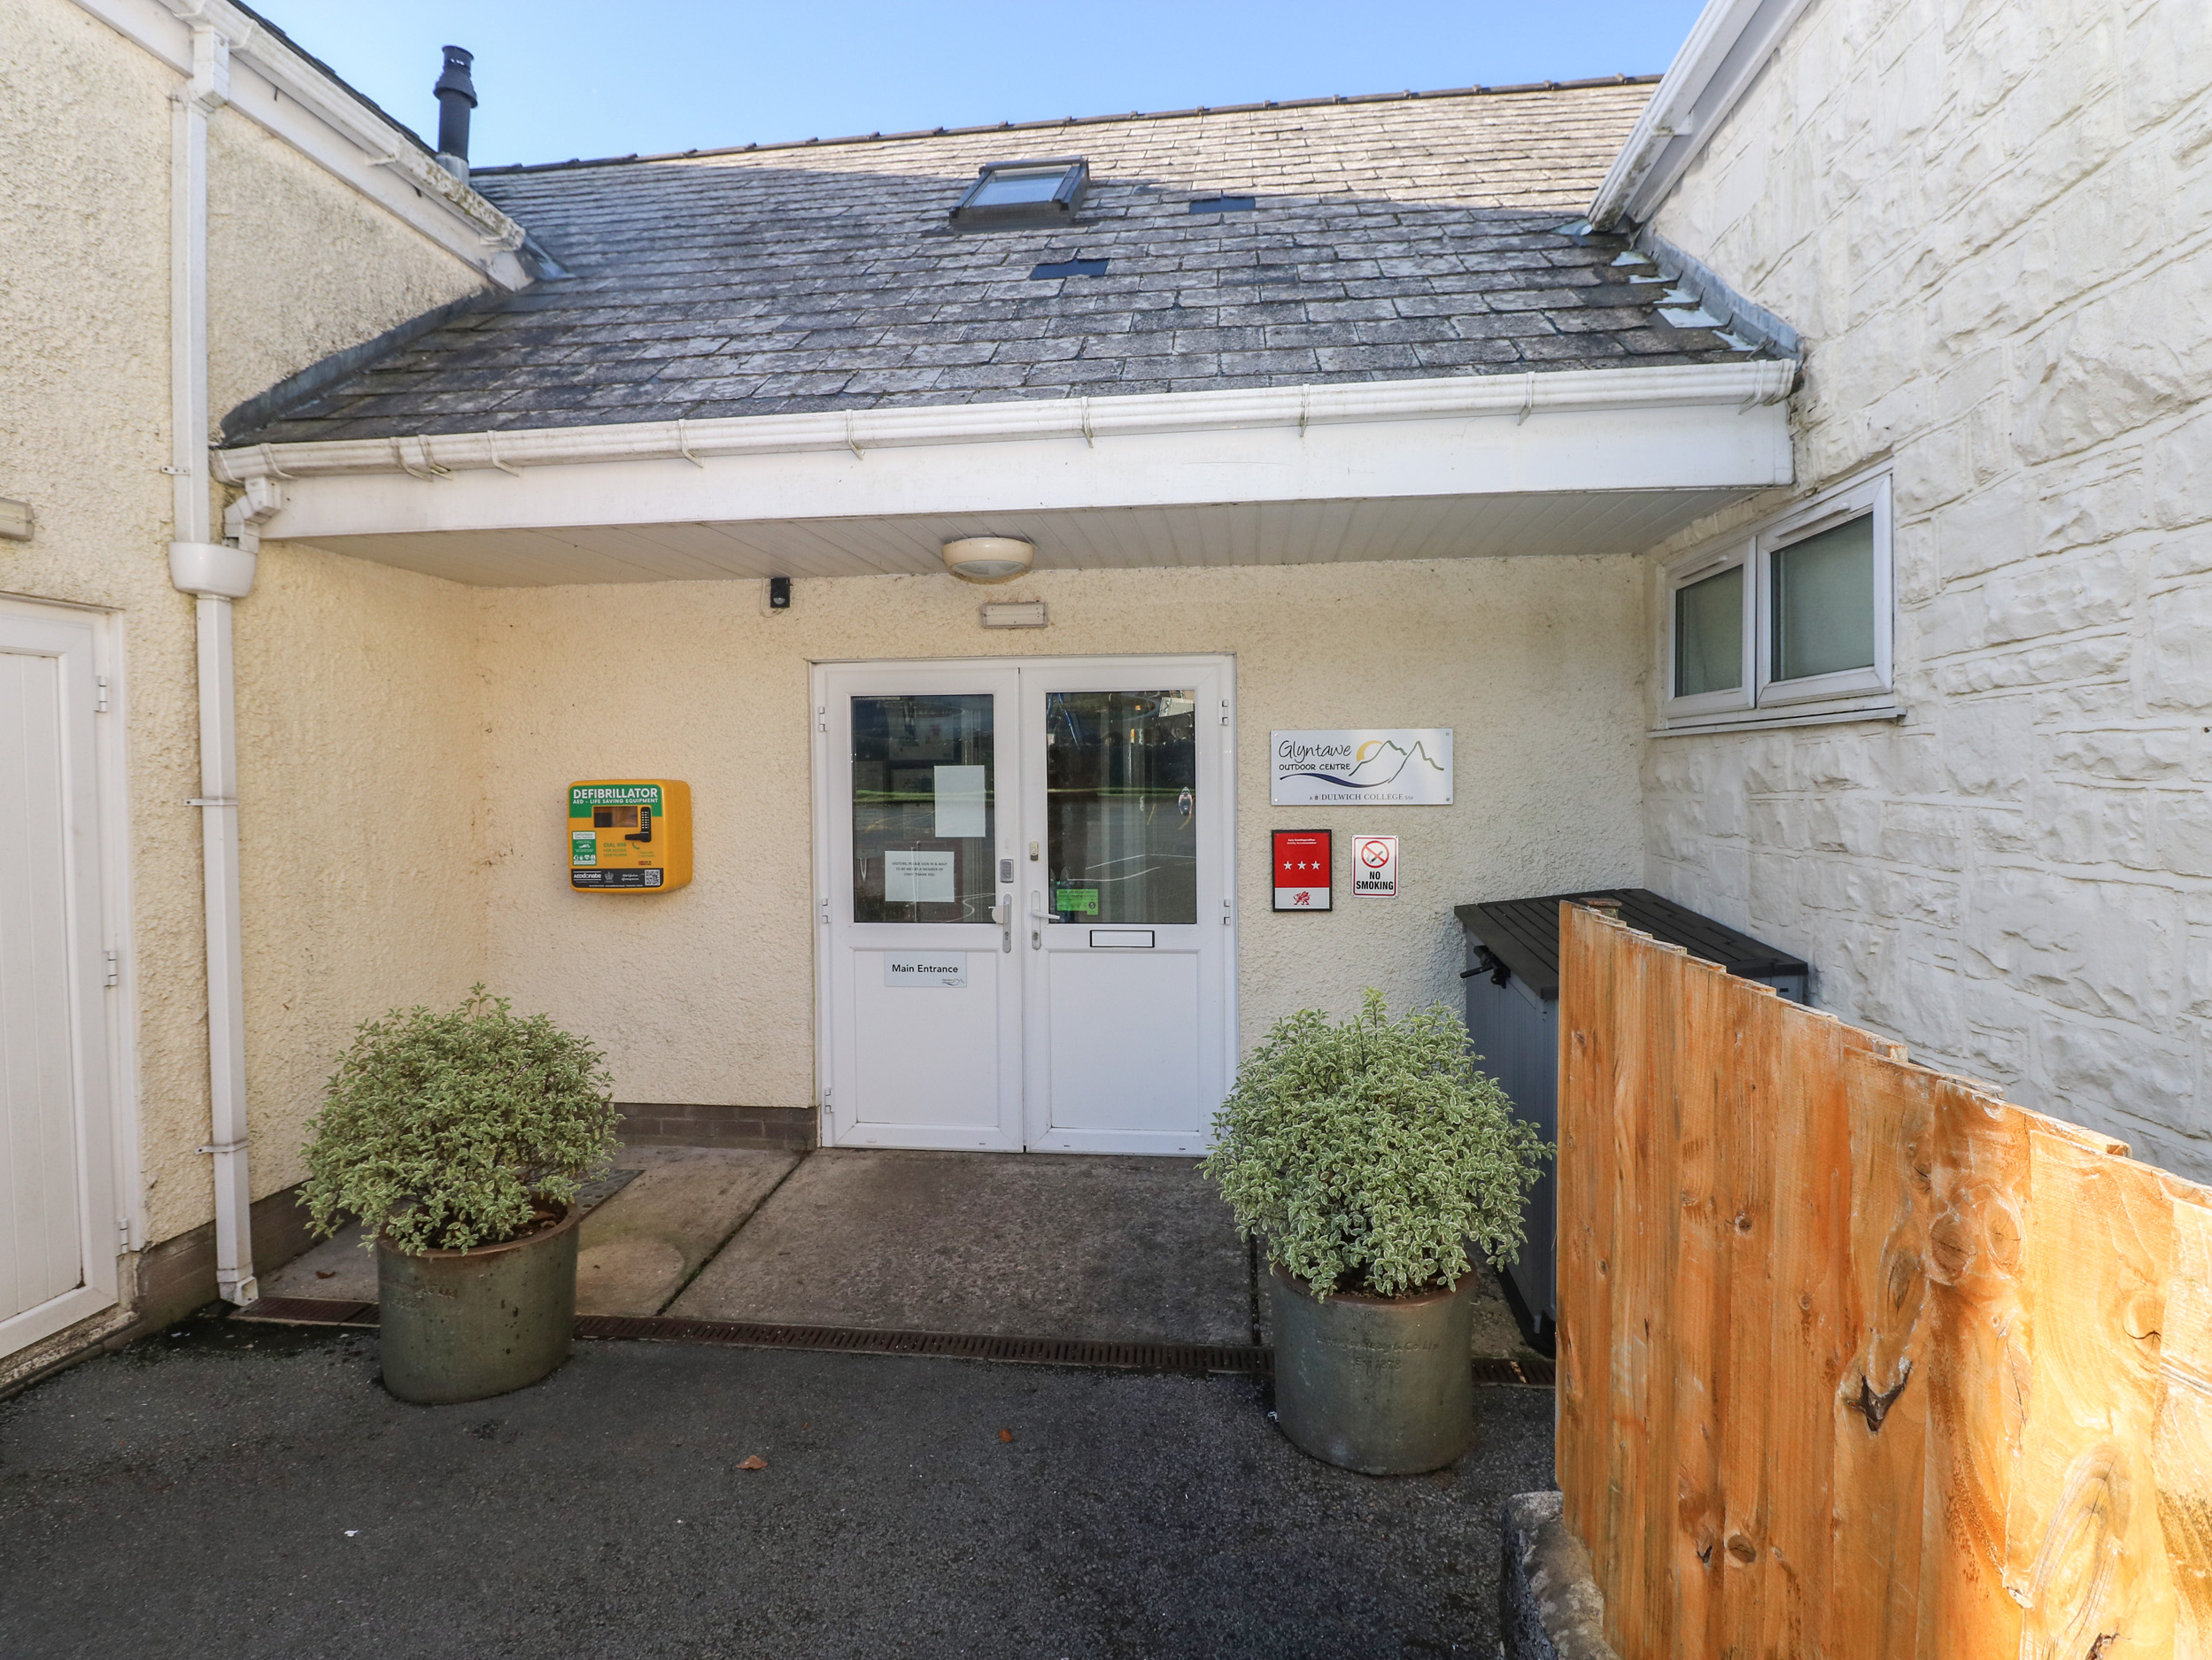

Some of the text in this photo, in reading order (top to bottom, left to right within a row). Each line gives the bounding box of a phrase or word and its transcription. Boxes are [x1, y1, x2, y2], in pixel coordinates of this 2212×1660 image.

[1279, 740, 1351, 763] Glyntawe
[573, 787, 658, 799] DEFIBRILLATOR
[1369, 870, 1381, 880] NO
[1356, 880, 1394, 890] SMOKING
[892, 963, 958, 973] Main Entrance
